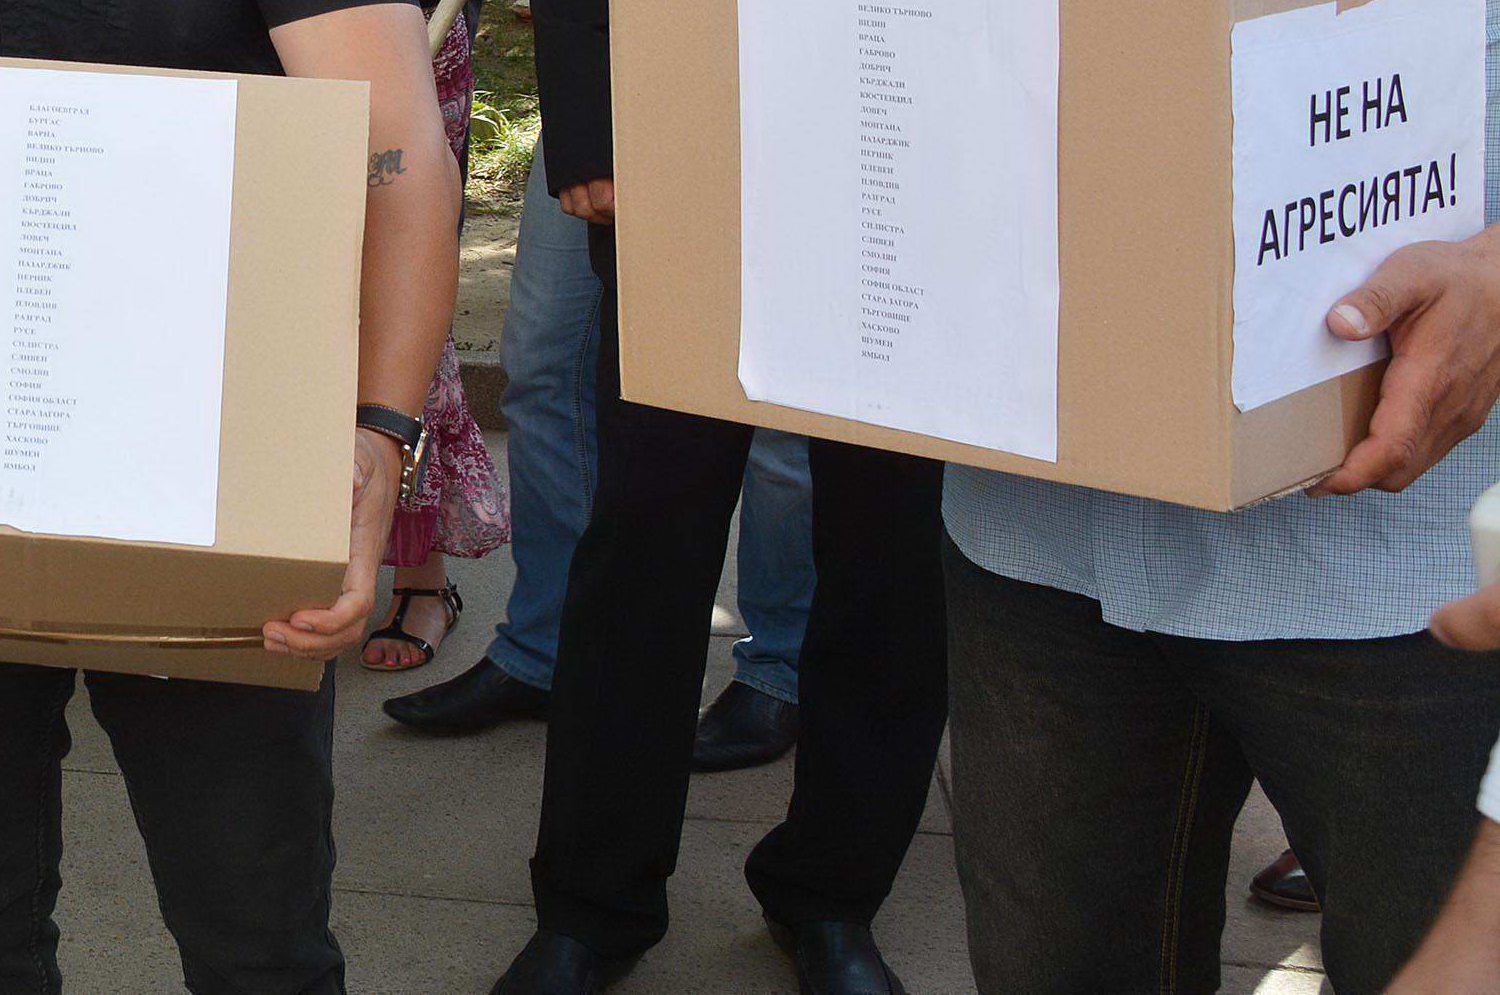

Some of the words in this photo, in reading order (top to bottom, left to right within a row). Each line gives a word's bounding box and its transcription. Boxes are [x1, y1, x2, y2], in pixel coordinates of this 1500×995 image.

[1309, 87, 1351, 147] НЕ
[1361, 72, 1408, 130] НА
[1256, 153, 1457, 266] АГРЕСИЯТА!
